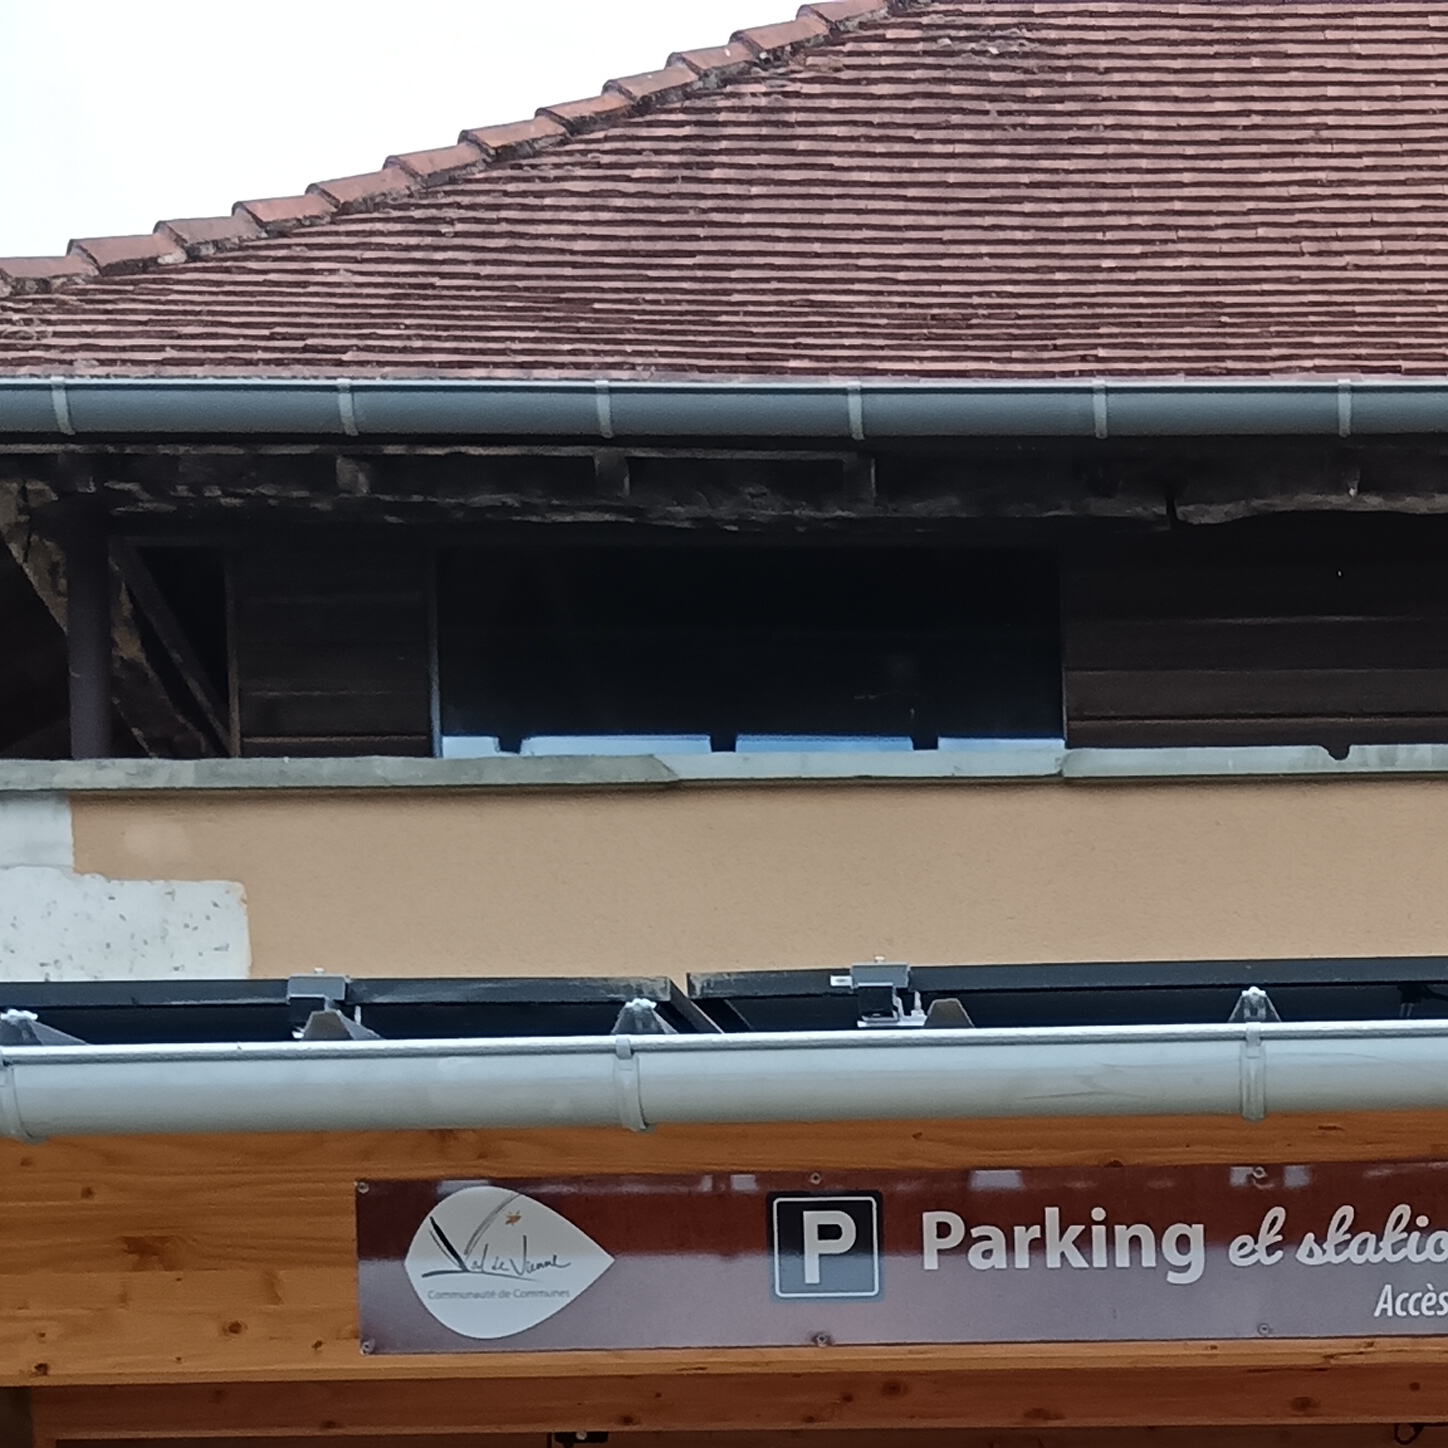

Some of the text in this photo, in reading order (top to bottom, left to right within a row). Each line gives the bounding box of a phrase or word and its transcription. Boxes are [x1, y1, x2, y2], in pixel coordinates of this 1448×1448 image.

[802, 1209, 857, 1285] P
[921, 1206, 1206, 1286] Parking
[1228, 1206, 1284, 1267] et
[427, 1288, 570, 1300] Communauté de Communes
